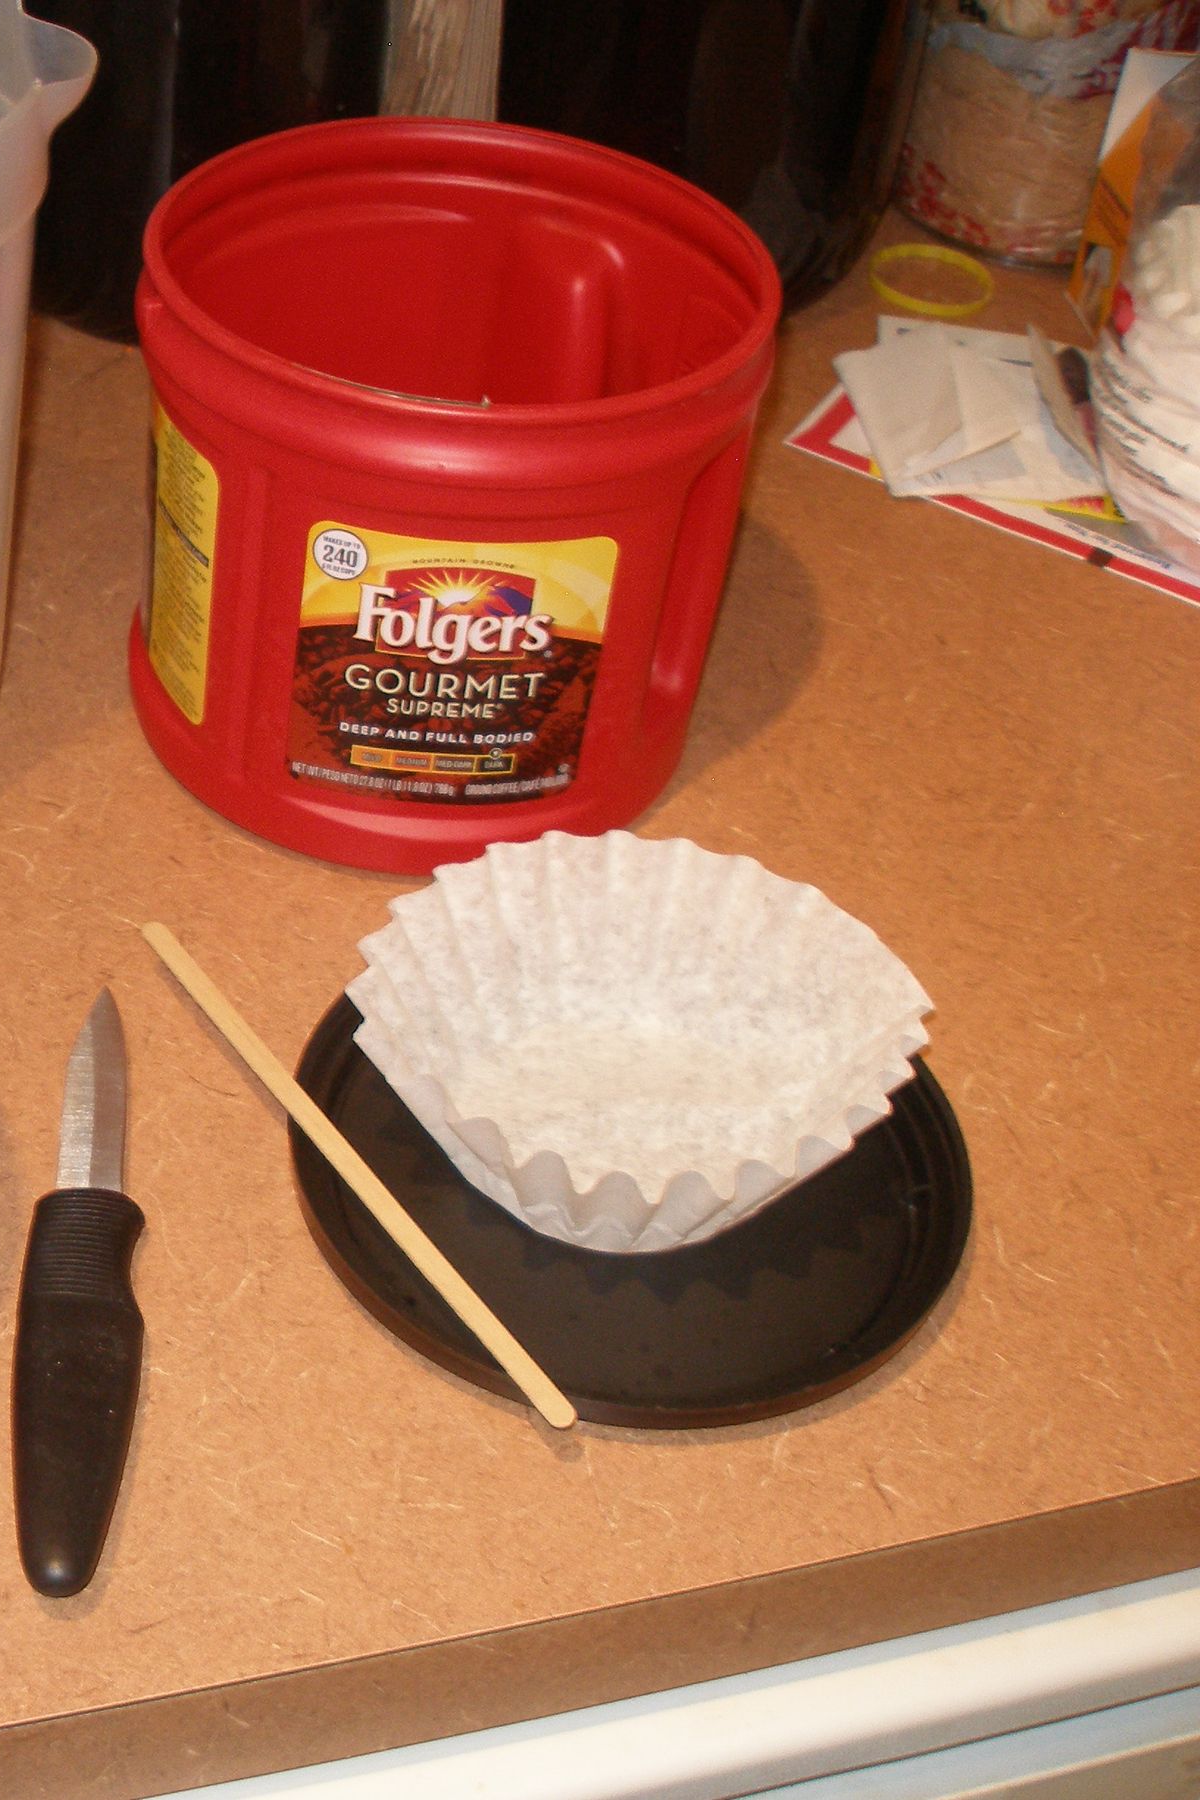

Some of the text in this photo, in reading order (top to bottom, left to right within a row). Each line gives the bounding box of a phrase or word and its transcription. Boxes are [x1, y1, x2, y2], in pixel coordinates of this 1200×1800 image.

[323, 545, 358, 567] 240
[352, 582, 554, 665] Folgers
[345, 663, 545, 699] GOURMET
[386, 698, 497, 719] SUPREME
[339, 722, 534, 744] DEEP AND FULL BODIED
